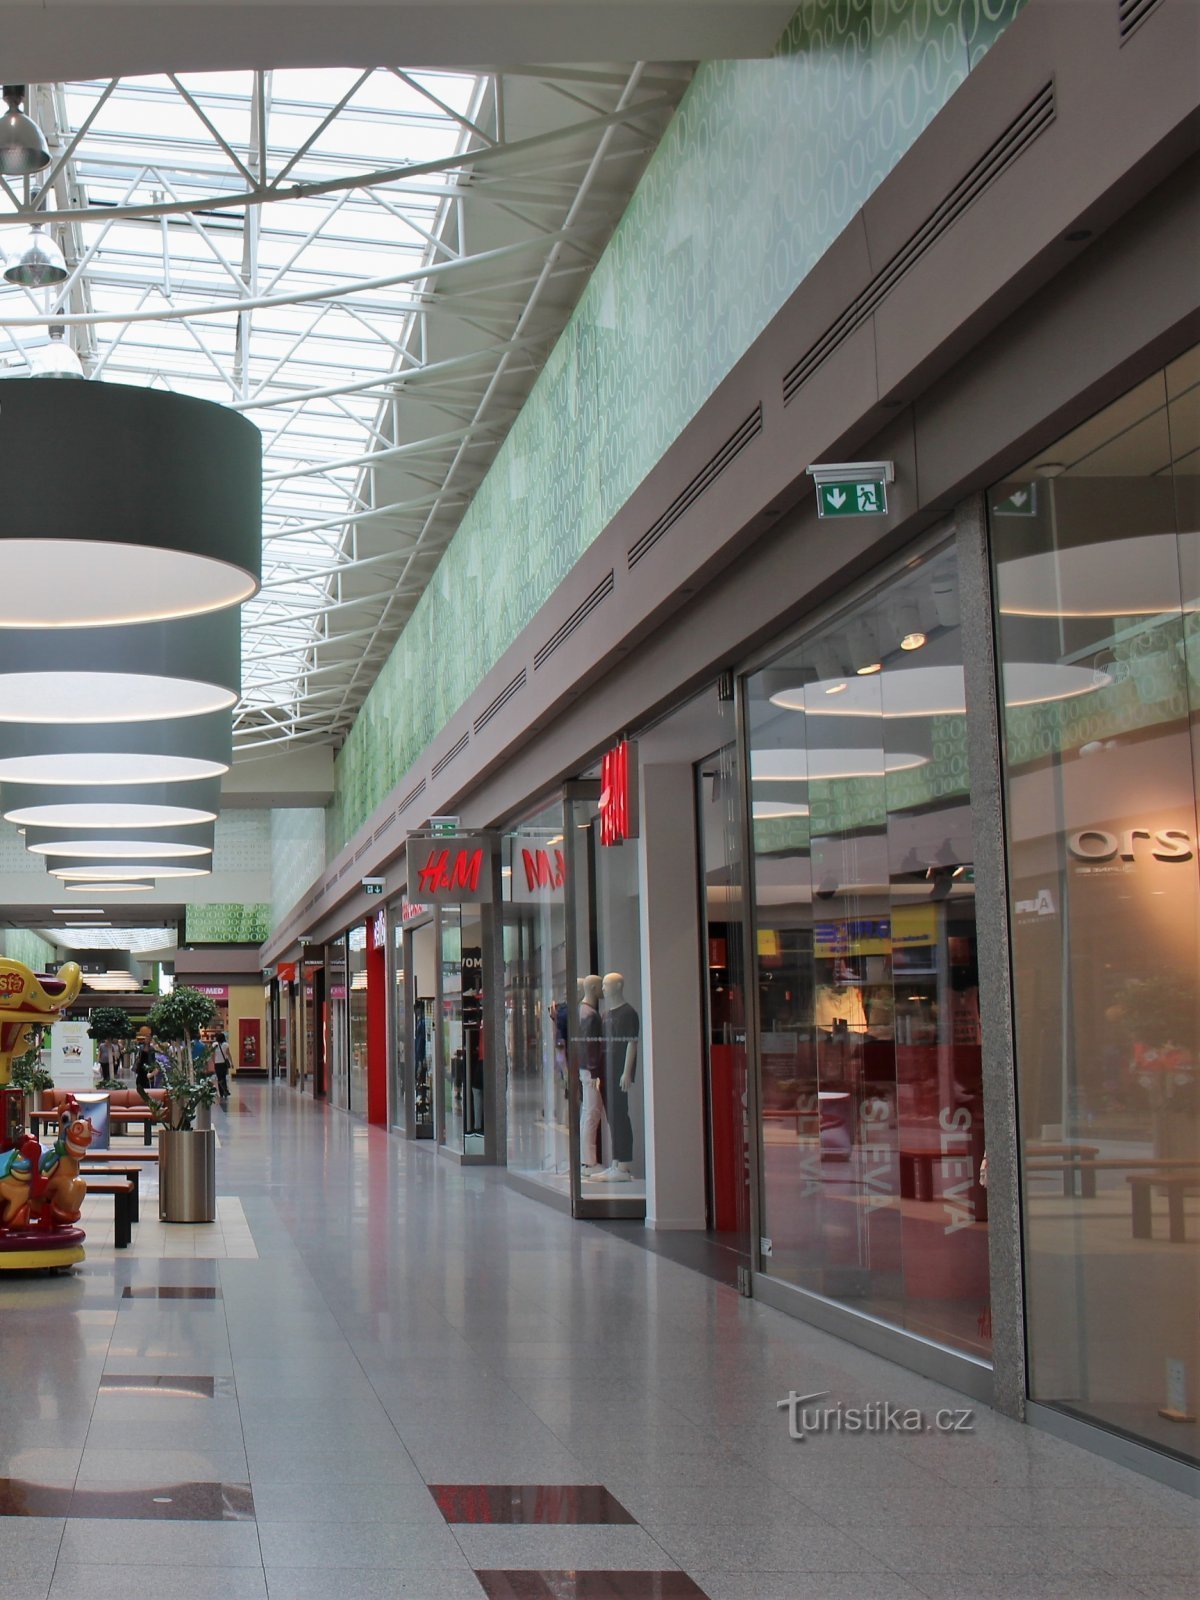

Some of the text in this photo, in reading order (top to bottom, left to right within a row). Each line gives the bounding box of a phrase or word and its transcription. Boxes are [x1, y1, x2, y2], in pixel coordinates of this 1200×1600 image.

[417, 848, 483, 893] H&M
[859, 1097, 893, 1214] SLEVA
[939, 1107, 976, 1235] SLEVA
